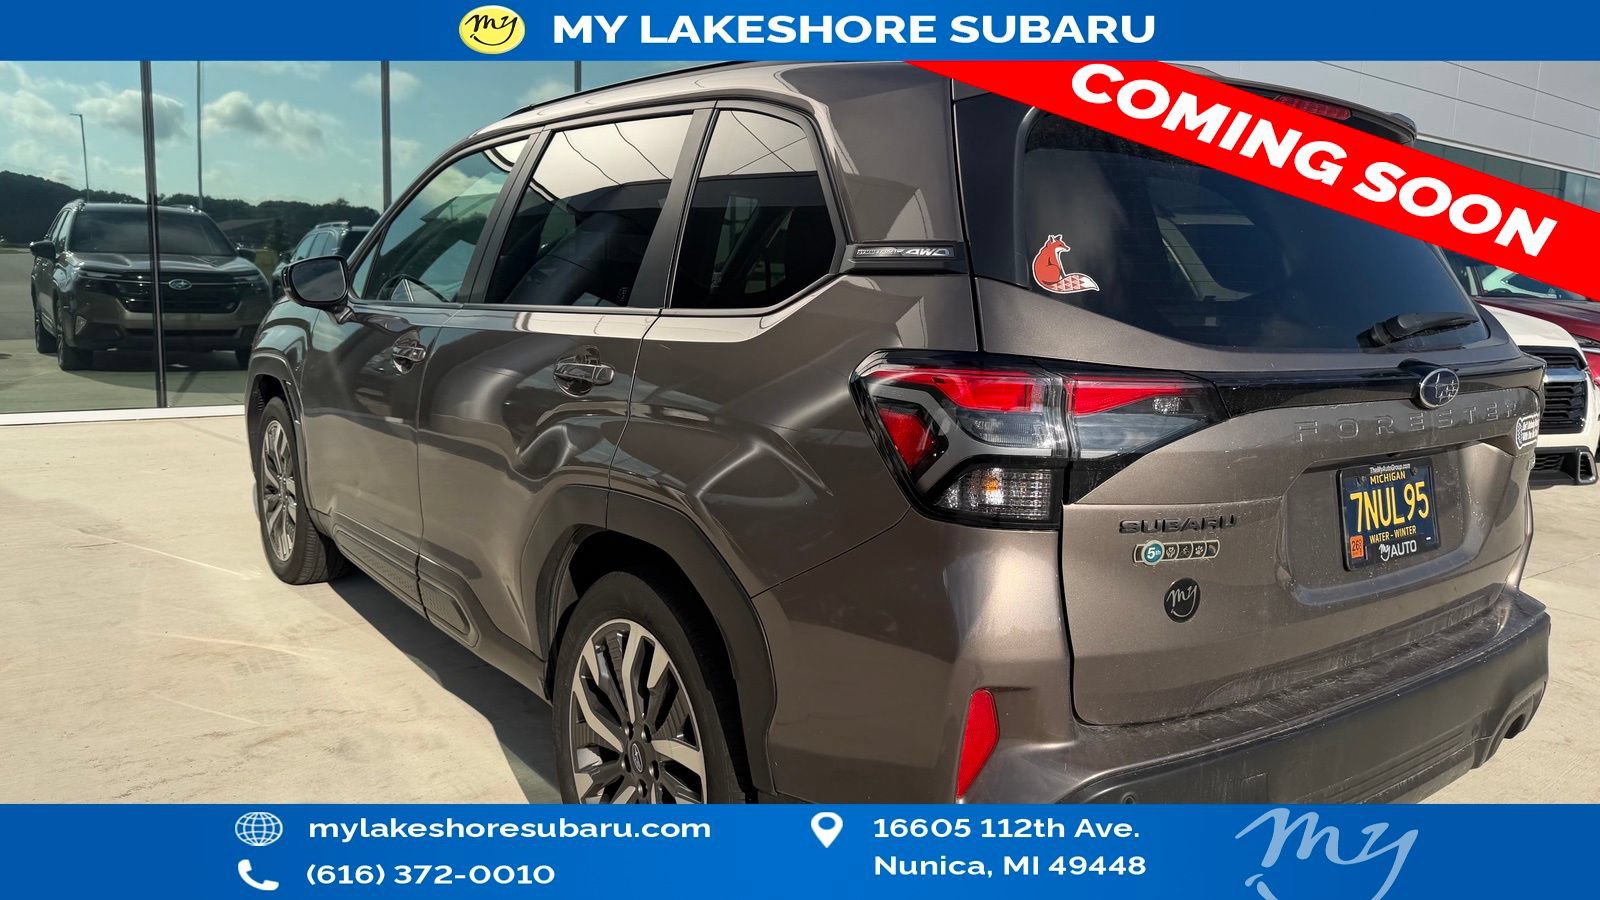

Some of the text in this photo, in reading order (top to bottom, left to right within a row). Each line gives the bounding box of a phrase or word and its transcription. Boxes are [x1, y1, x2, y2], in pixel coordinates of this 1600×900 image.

[905, 248, 951, 256] AWD
[1294, 399, 1518, 442] FORESTER
[1370, 470, 1406, 485] MICHIGAN
[1350, 481, 1430, 533] 7NUL95
[1119, 514, 1238, 534] SUBARU
[1370, 531, 1390, 544] WATER
[1394, 525, 1417, 538] WINTER
[1146, 546, 1161, 559] 5th
